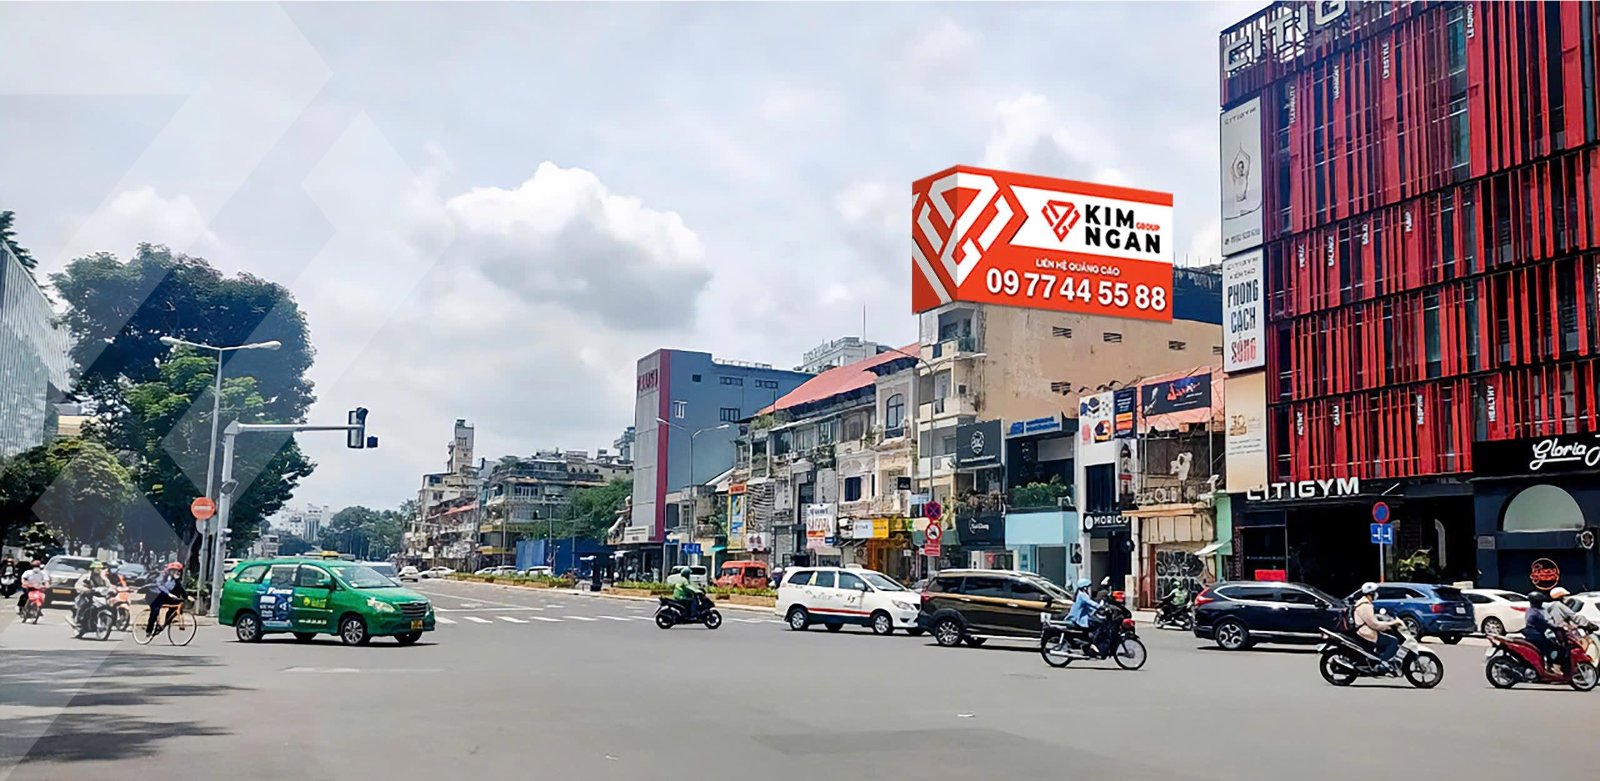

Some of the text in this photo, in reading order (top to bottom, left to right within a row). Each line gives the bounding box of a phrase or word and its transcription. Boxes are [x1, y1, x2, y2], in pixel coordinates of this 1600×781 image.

[1085, 204, 1161, 232] KIM GROUP
[1085, 226, 1161, 254] NGAN
[986, 268, 1020, 295] 09
[1134, 284, 1167, 312] 88
[1227, 279, 1259, 308] PHONG
[1487, 385, 1496, 422] HEALTHY
[1529, 438, 1587, 470] Gloria
[1247, 477, 1360, 501] CITIGYM
